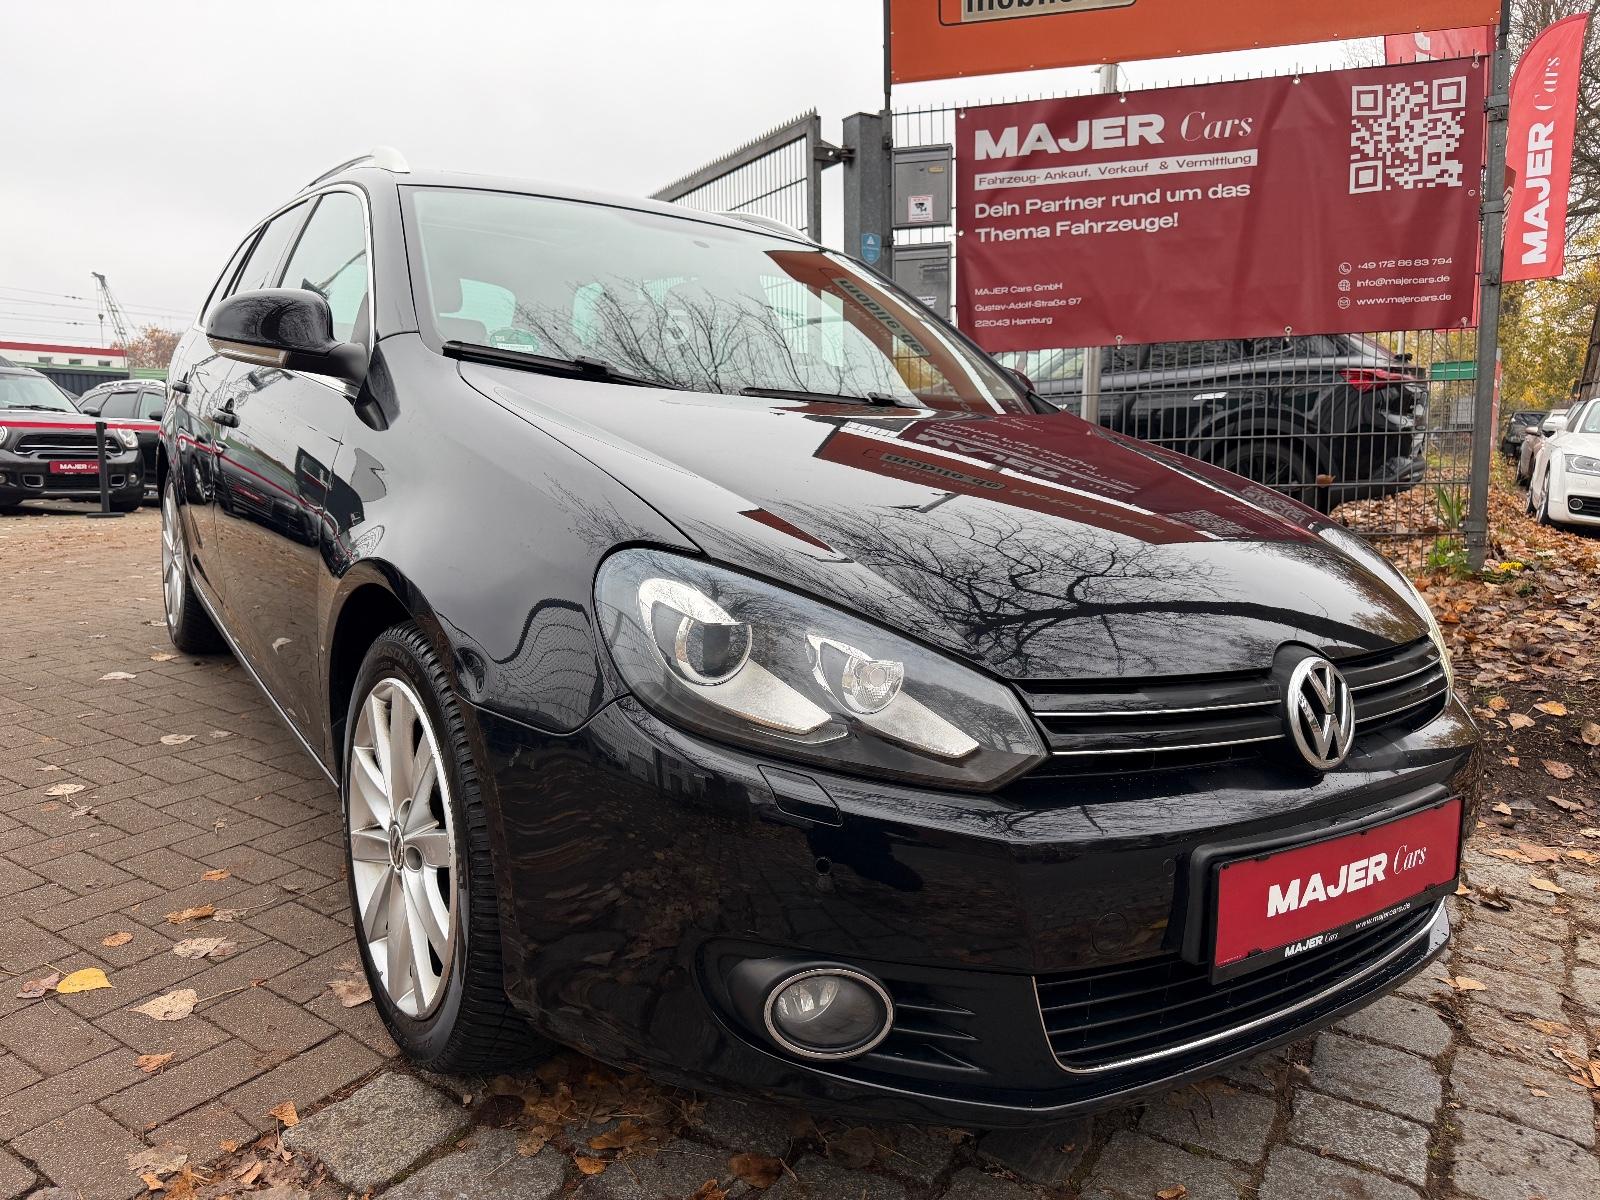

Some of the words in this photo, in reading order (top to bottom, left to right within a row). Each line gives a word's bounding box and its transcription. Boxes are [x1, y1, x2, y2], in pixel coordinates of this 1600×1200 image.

[1532, 56, 1561, 111] Cars
[974, 113, 1165, 161] MAJER
[1180, 111, 1253, 142] Cars
[1098, 162, 1149, 176] Verkauf
[1159, 161, 1169, 170] &
[1176, 154, 1252, 169] Vermittlung
[974, 201, 1020, 219] Dein
[1025, 195, 1106, 215] Partner
[1111, 188, 1161, 207] rund
[1166, 187, 1202, 202] um
[1207, 183, 1251, 199] das
[1521, 120, 1555, 265] MAJER
[974, 223, 1051, 243] Thema
[1055, 212, 1179, 238] Fahrzeuge!
[1379, 260, 1396, 268] 172
[1397, 259, 1413, 267] 86
[1413, 258, 1430, 267] 83
[1431, 257, 1453, 266] 794
[974, 286, 1009, 296] MAJER
[1009, 284, 1033, 294] Cars
[1033, 282, 1063, 292] GmbH
[1356, 274, 1451, 288] info@majercars.de
[974, 298, 1067, 312] Gustav-Adolf-Straße
[1067, 297, 1082, 306] 97
[1356, 292, 1452, 305] www.majercars.de
[974, 318, 1011, 328] 22043
[1012, 316, 1053, 326] Hamburg
[1266, 852, 1388, 918] MAJER
[1393, 844, 1427, 876] Cars
[1284, 935, 1324, 958] MAJER
